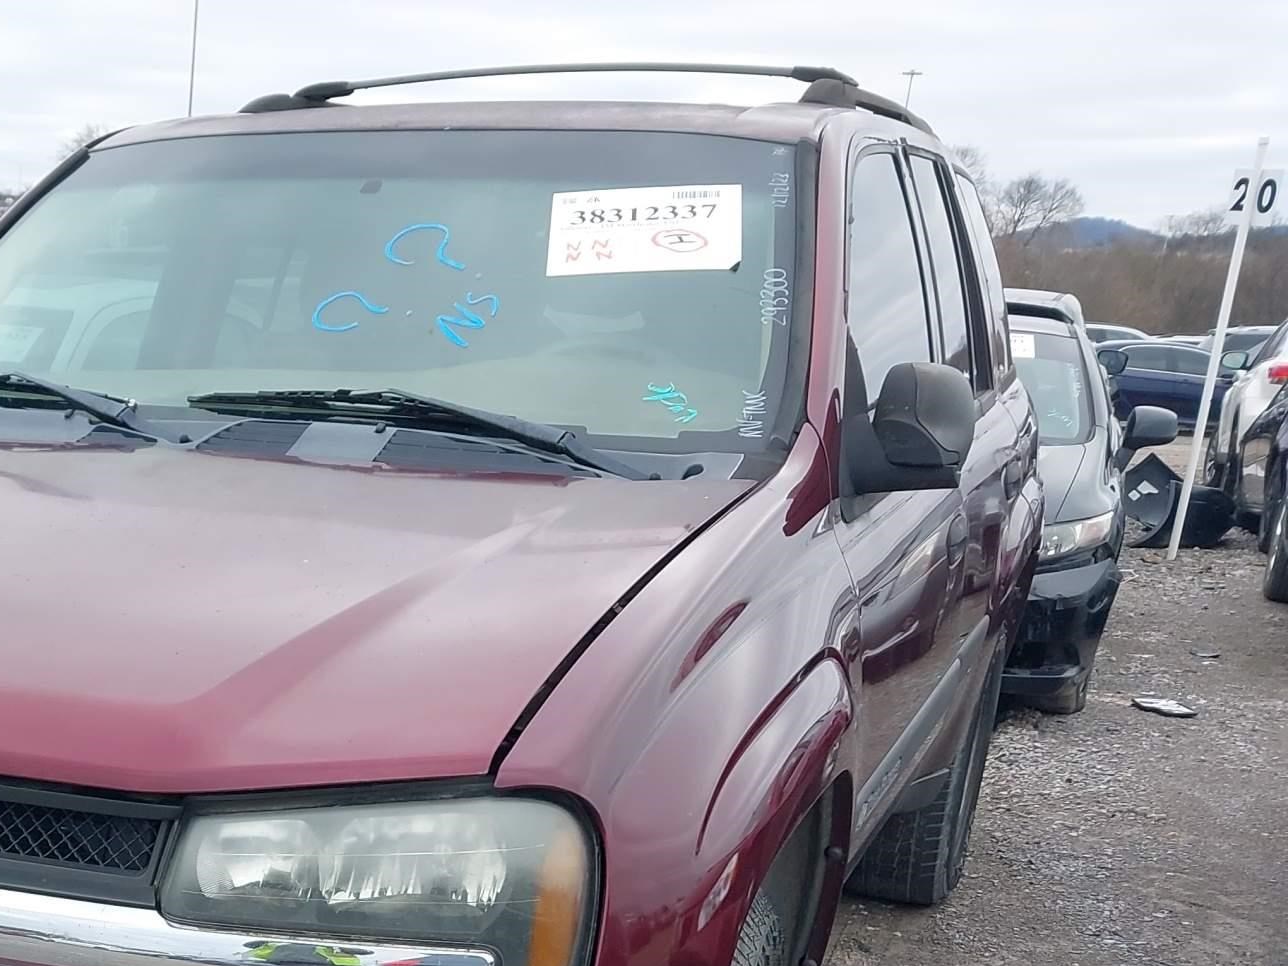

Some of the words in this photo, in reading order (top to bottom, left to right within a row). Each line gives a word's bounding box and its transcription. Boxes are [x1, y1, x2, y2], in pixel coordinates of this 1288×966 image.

[1229, 177, 1277, 214] 20
[569, 203, 717, 226] 38312337
[759, 268, 789, 326] 293300
